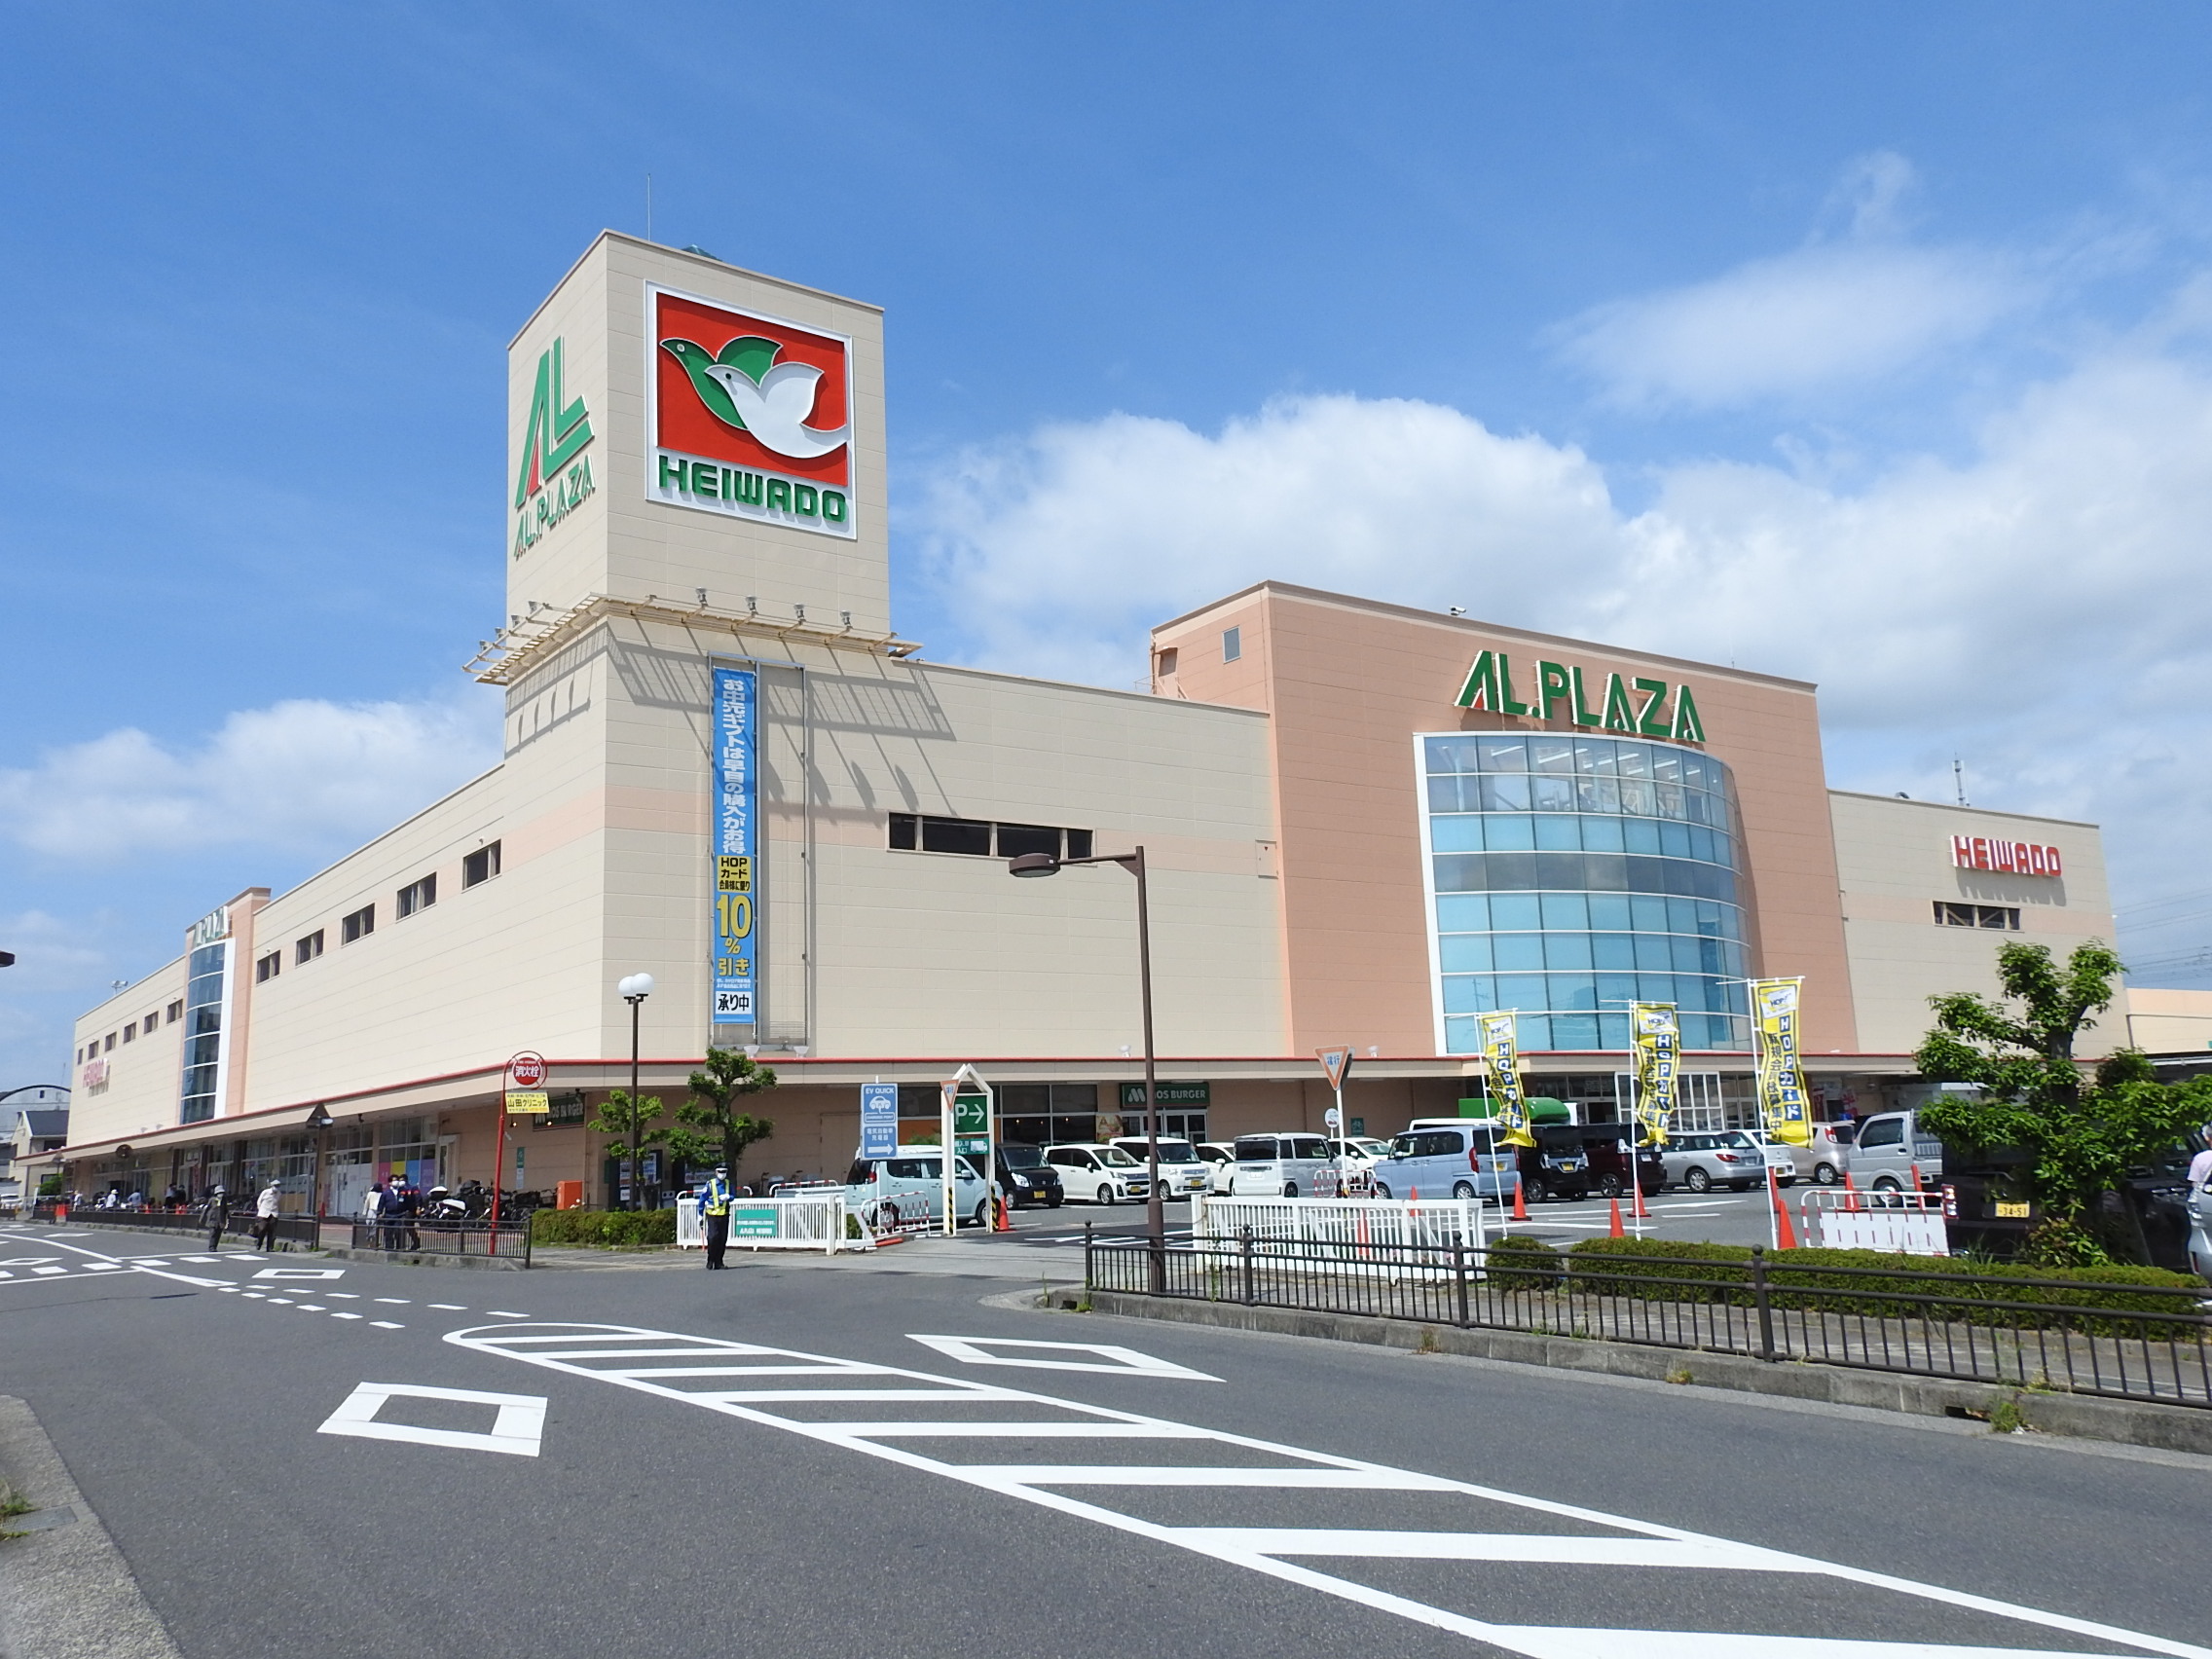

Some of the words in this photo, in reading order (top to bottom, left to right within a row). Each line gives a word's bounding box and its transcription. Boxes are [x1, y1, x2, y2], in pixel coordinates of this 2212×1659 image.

[659, 455, 847, 523] HEIWADO
[1454, 649, 1706, 742] AL.PLAZA
[720, 857, 748, 866] HOP
[1950, 835, 2062, 876] HEIWADO
[720, 868, 748, 878] カード
[717, 894, 753, 939] 10
[719, 958, 750, 977] 引き
[718, 993, 750, 1012] 承り中
[515, 1065, 540, 1078] 消火栓
[507, 1098, 547, 1107] 山田クリニック
[1170, 1089, 1206, 1099] BURGER
[954, 1103, 969, 1125] P
